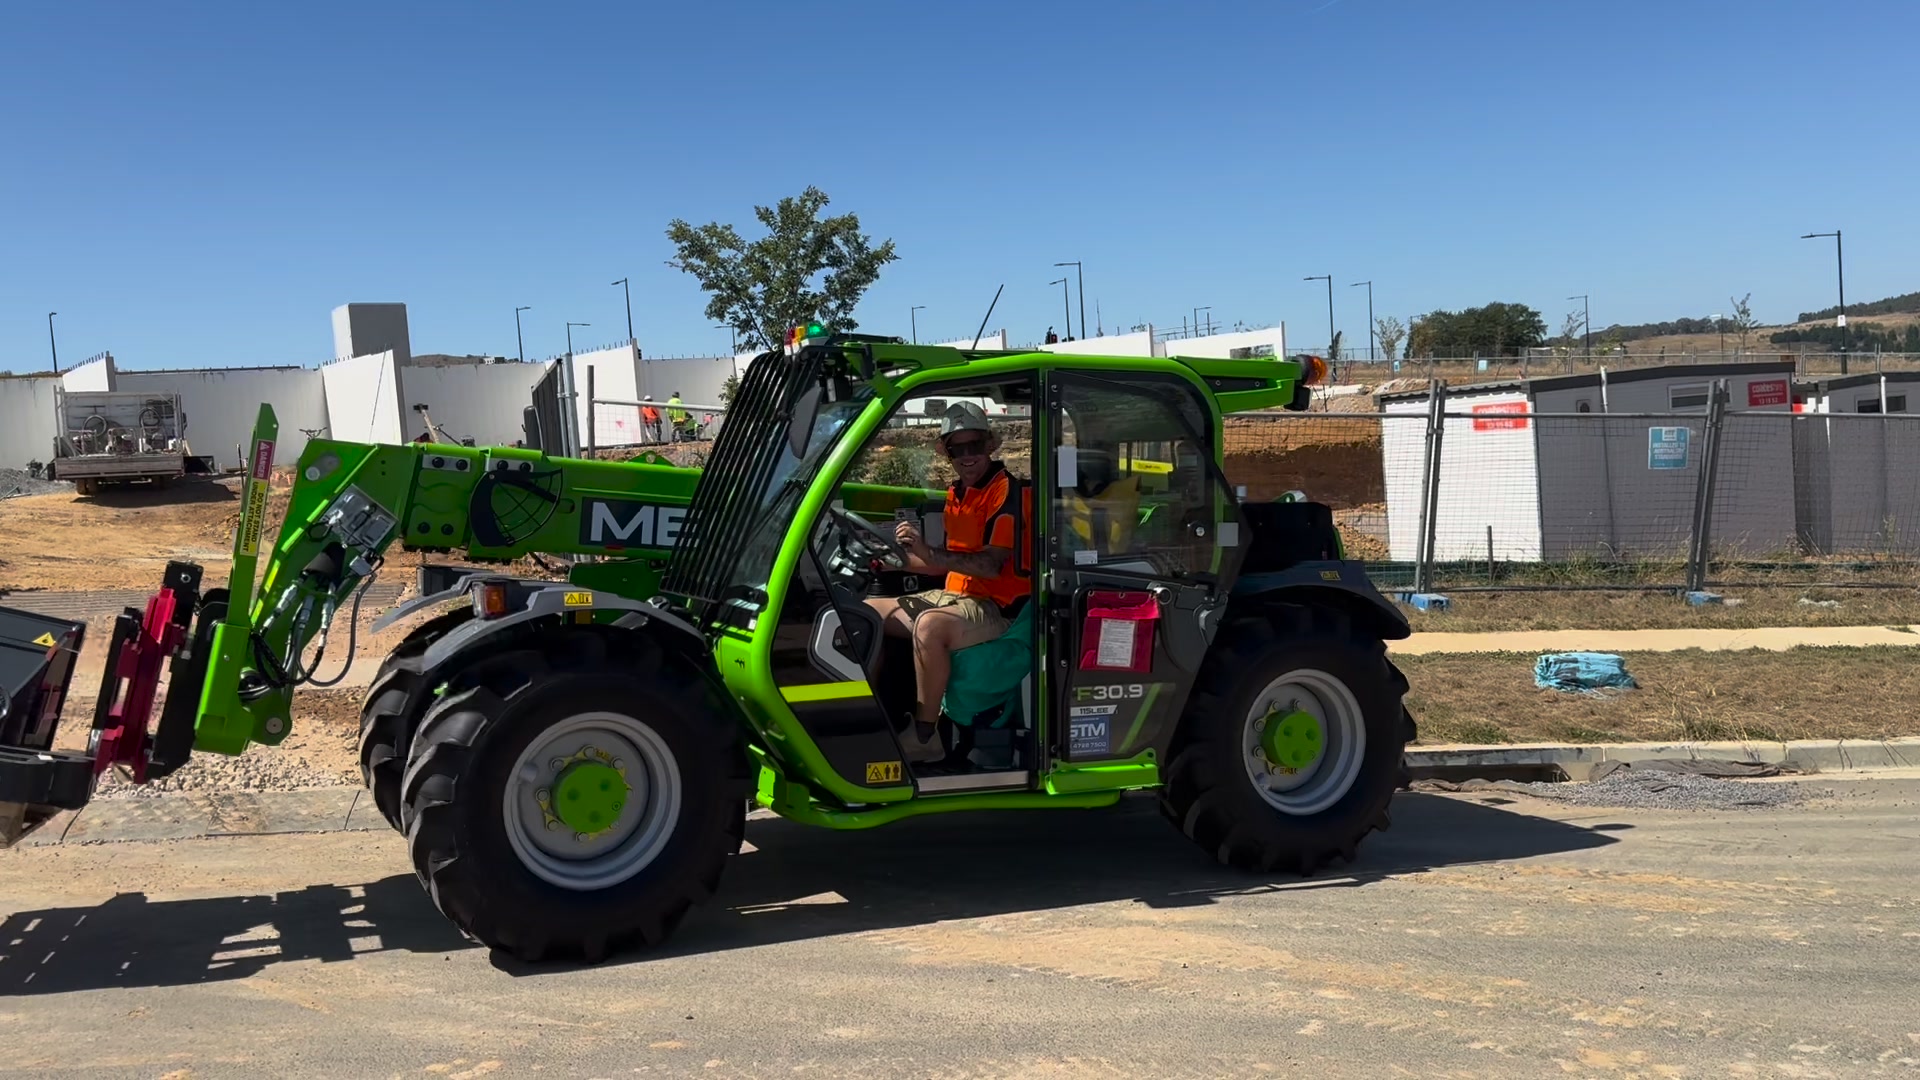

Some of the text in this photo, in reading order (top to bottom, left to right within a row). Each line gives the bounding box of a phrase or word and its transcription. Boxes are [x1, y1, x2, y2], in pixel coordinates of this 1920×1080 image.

[256, 451, 267, 478] DANGER
[243, 482, 258, 552] UNDER ATTACHMENT
[251, 492, 264, 542] DO NOT STAND
[1073, 684, 1143, 701] F30.9
